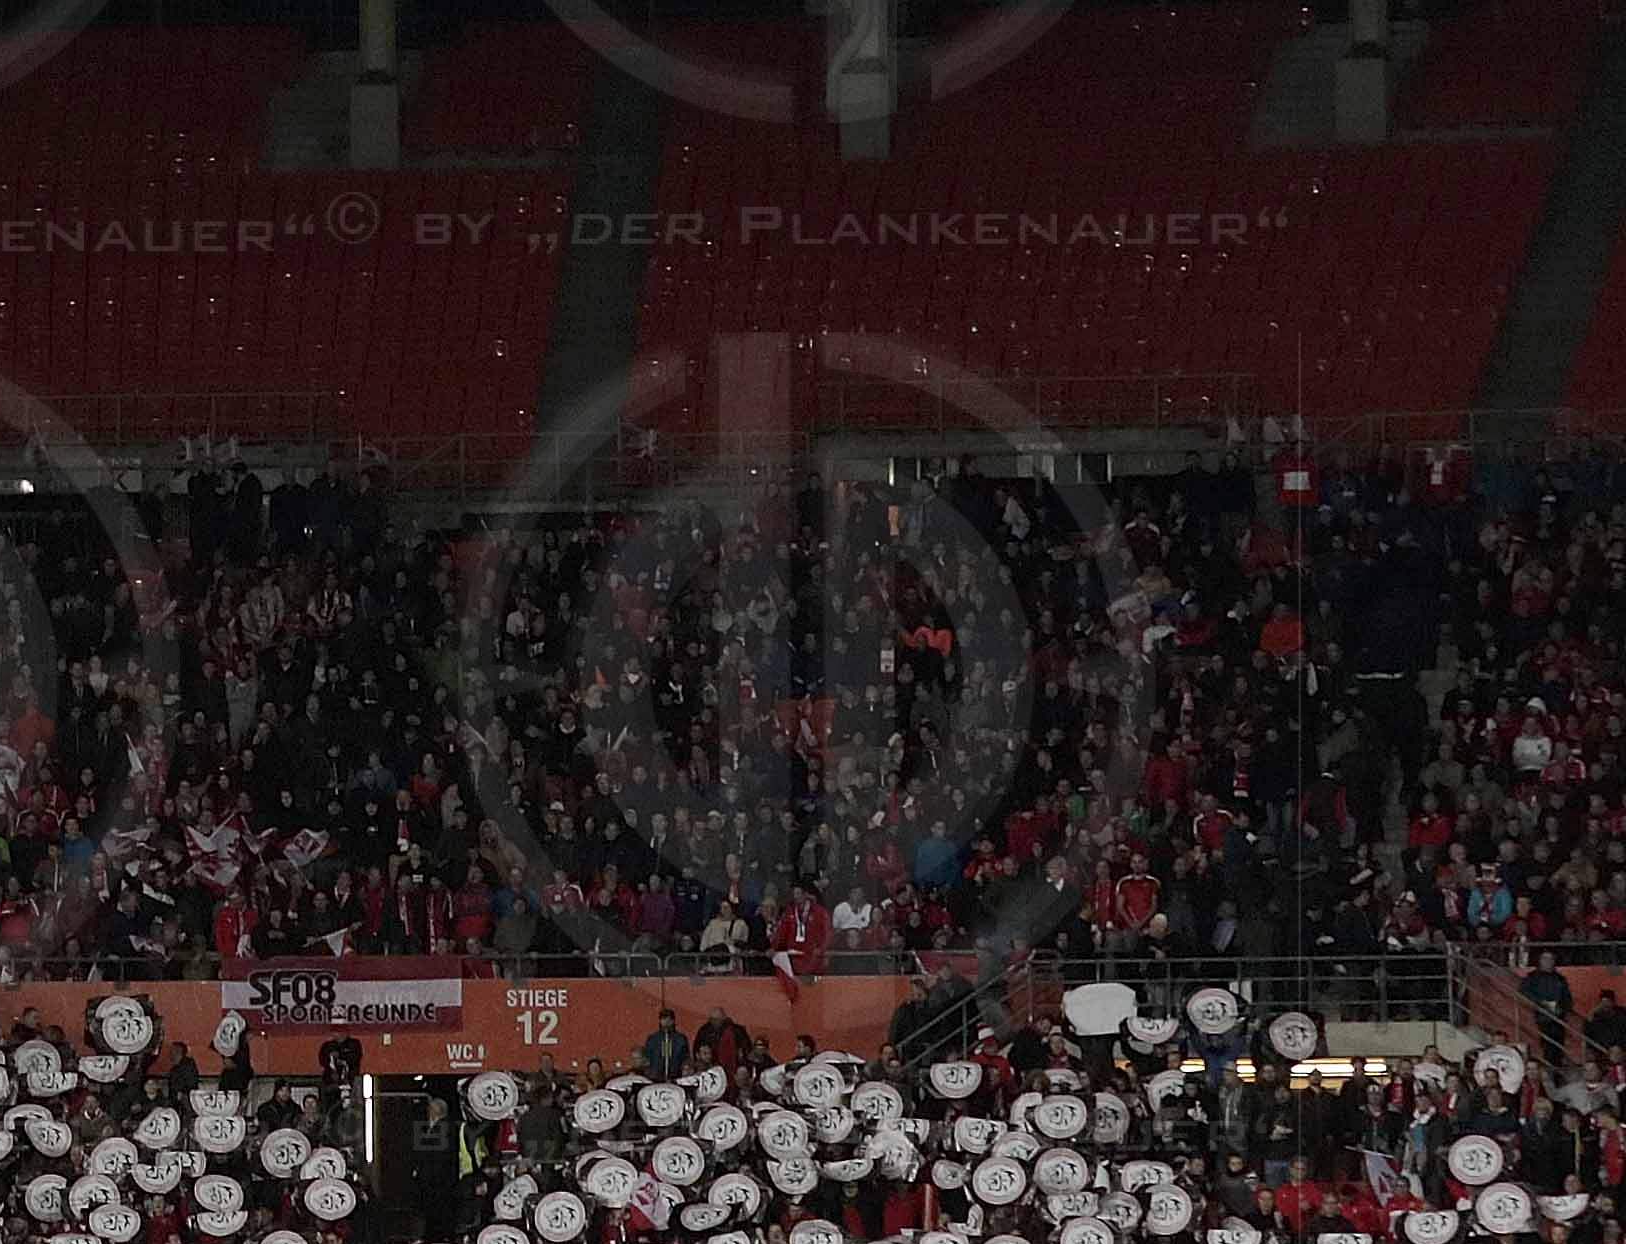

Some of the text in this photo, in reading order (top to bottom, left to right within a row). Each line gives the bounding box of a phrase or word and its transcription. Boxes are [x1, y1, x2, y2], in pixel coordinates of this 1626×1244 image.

[248, 970, 338, 1007] SF08
[506, 989, 568, 1008] STIEGE
[516, 1010, 559, 1045] 12
[446, 1043, 473, 1060] WC
